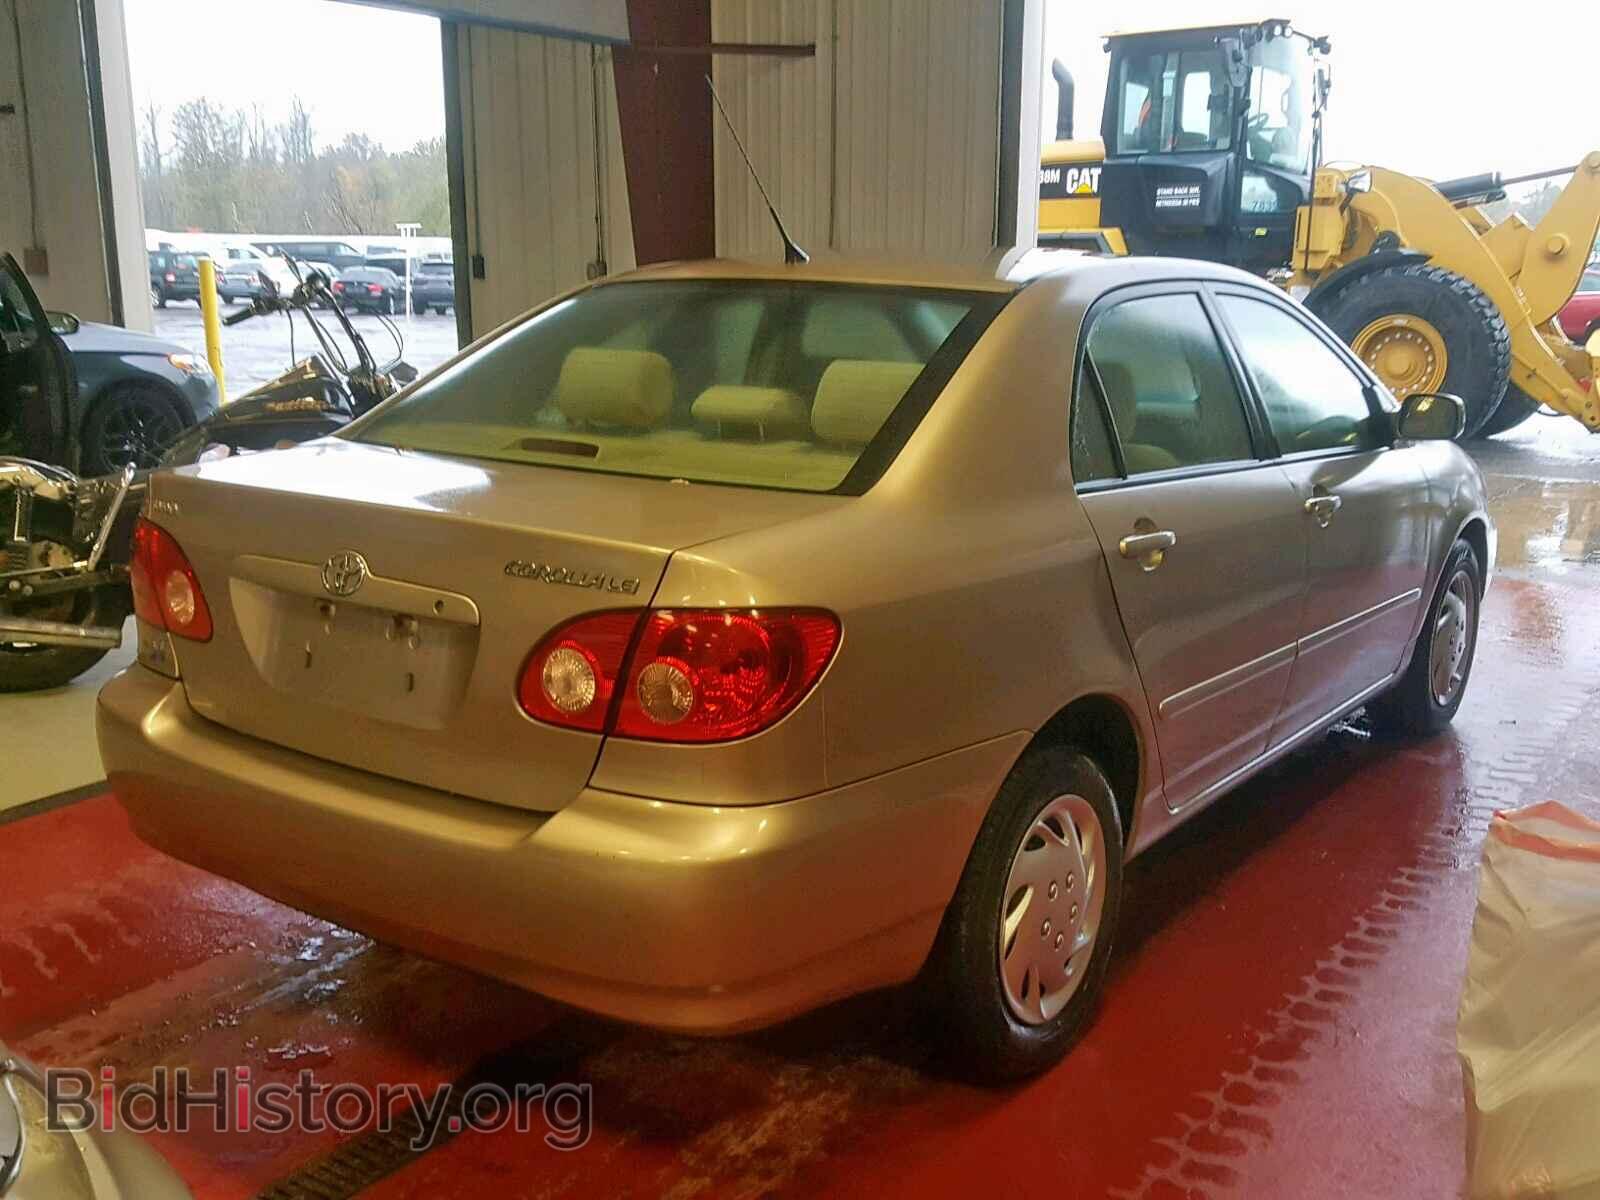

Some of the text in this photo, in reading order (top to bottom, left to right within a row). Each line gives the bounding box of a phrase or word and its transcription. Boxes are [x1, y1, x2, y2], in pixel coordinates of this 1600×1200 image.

[1066, 167, 1102, 194] CAT
[503, 559, 641, 595] COROLLA LE
